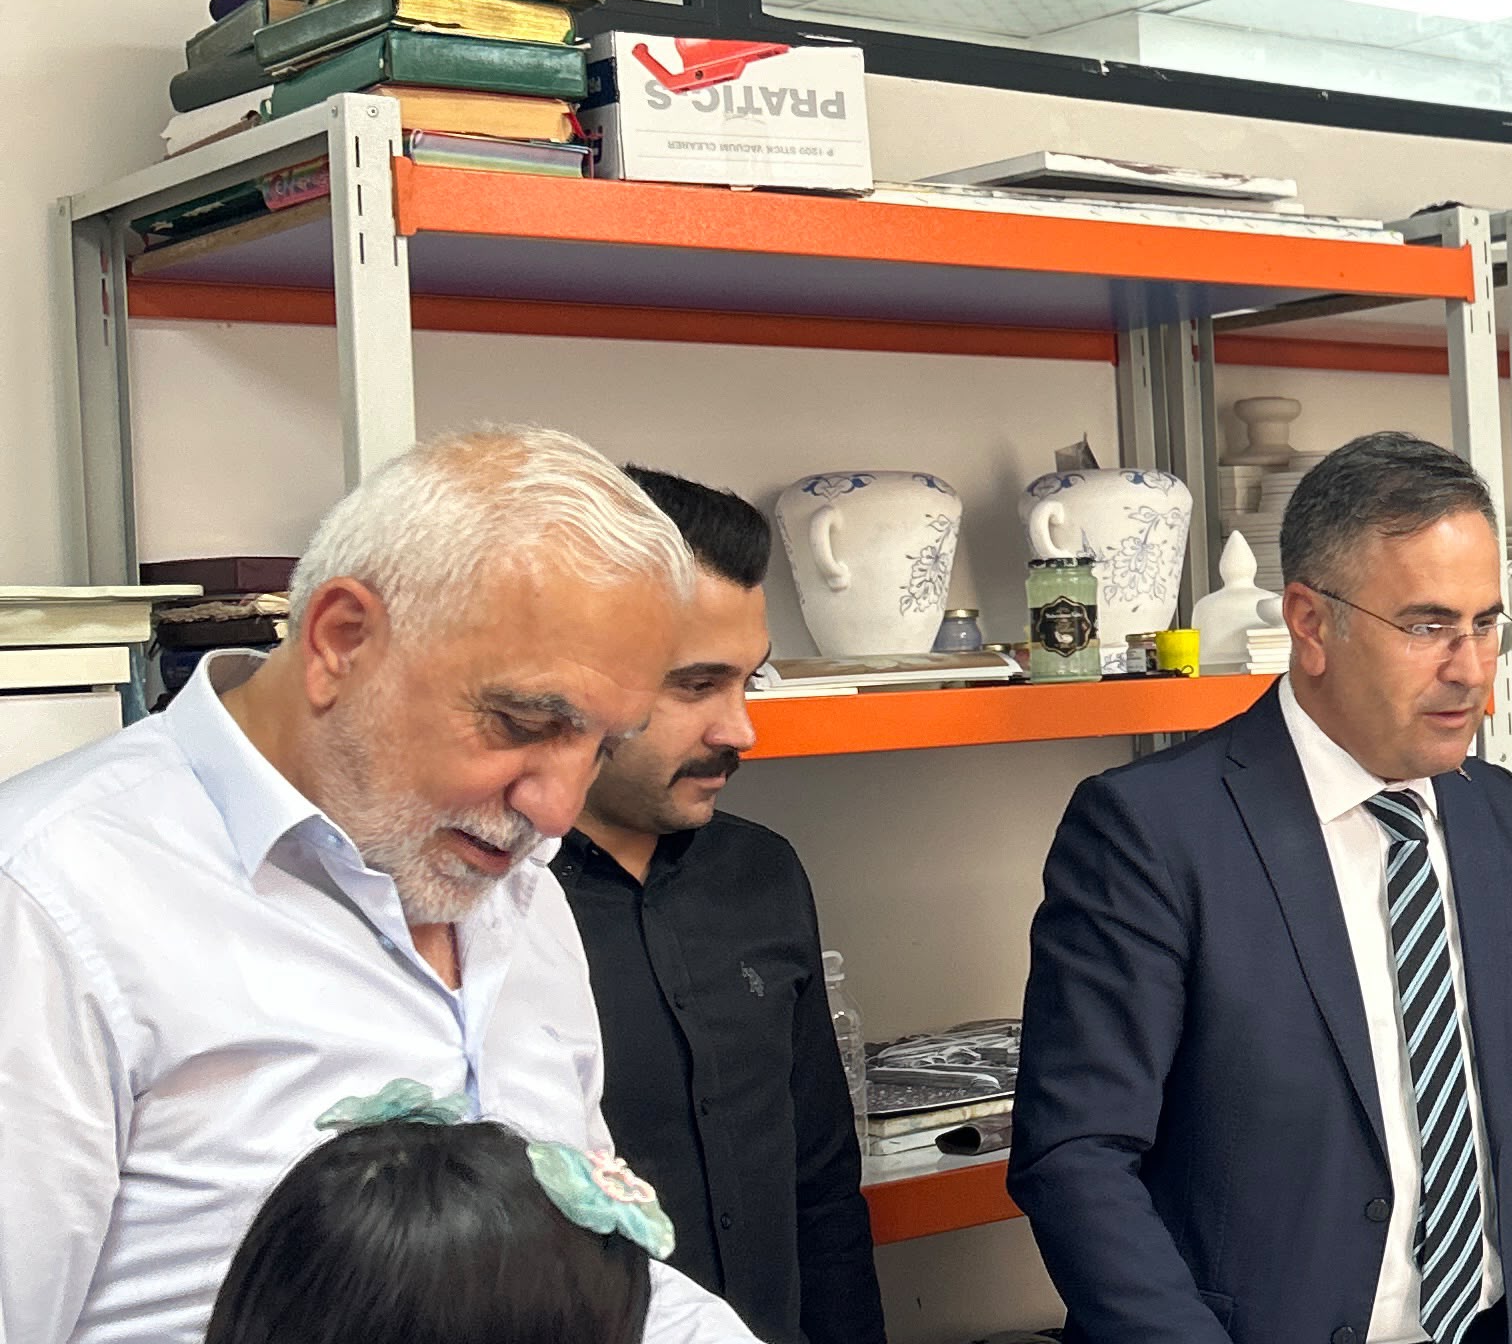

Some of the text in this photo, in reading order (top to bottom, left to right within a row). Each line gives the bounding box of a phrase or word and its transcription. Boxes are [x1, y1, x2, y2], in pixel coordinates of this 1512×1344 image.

[667, 140, 717, 152] CLEANER
[719, 143, 763, 154] VACUUM
[766, 145, 797, 155] STICK
